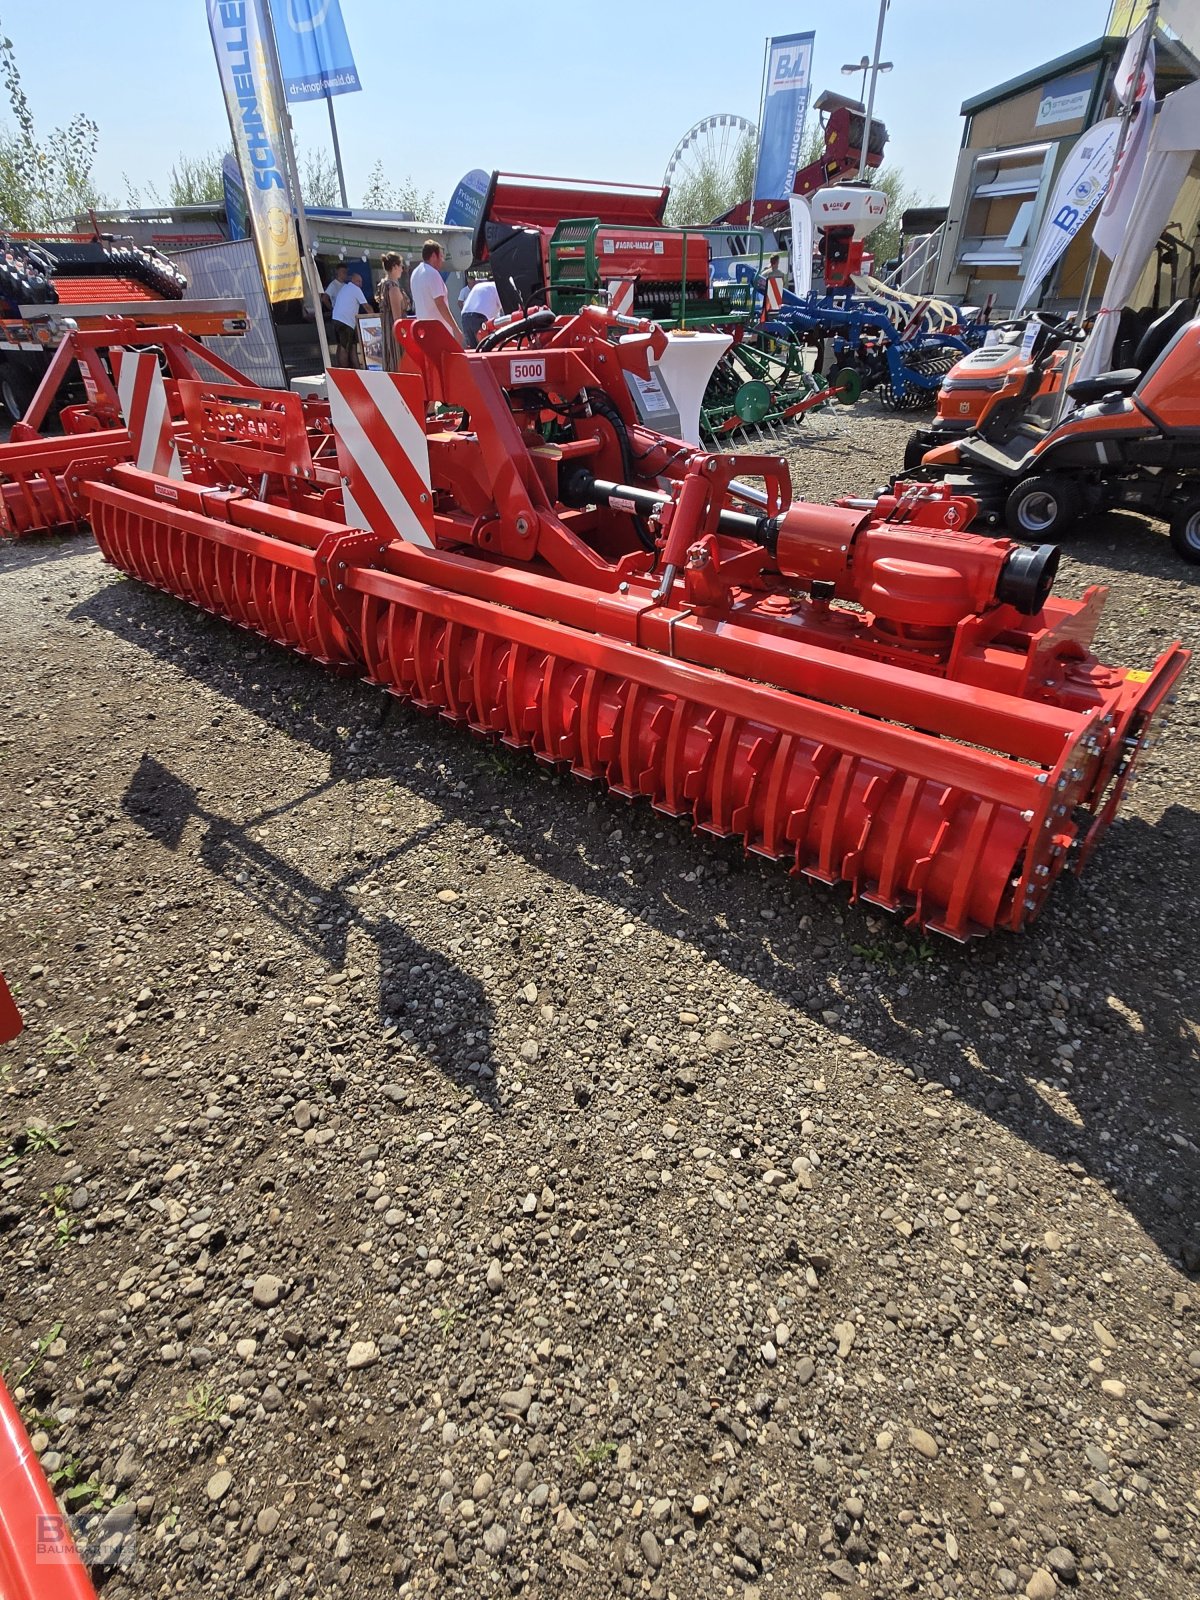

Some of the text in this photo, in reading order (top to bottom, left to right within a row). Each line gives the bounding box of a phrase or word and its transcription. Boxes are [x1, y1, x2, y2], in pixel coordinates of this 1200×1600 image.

[218, 0, 285, 190] SCHNELLE
[783, 168, 795, 195] VAN
[789, 95, 806, 165] LENGERICH
[514, 364, 543, 378] 5000
